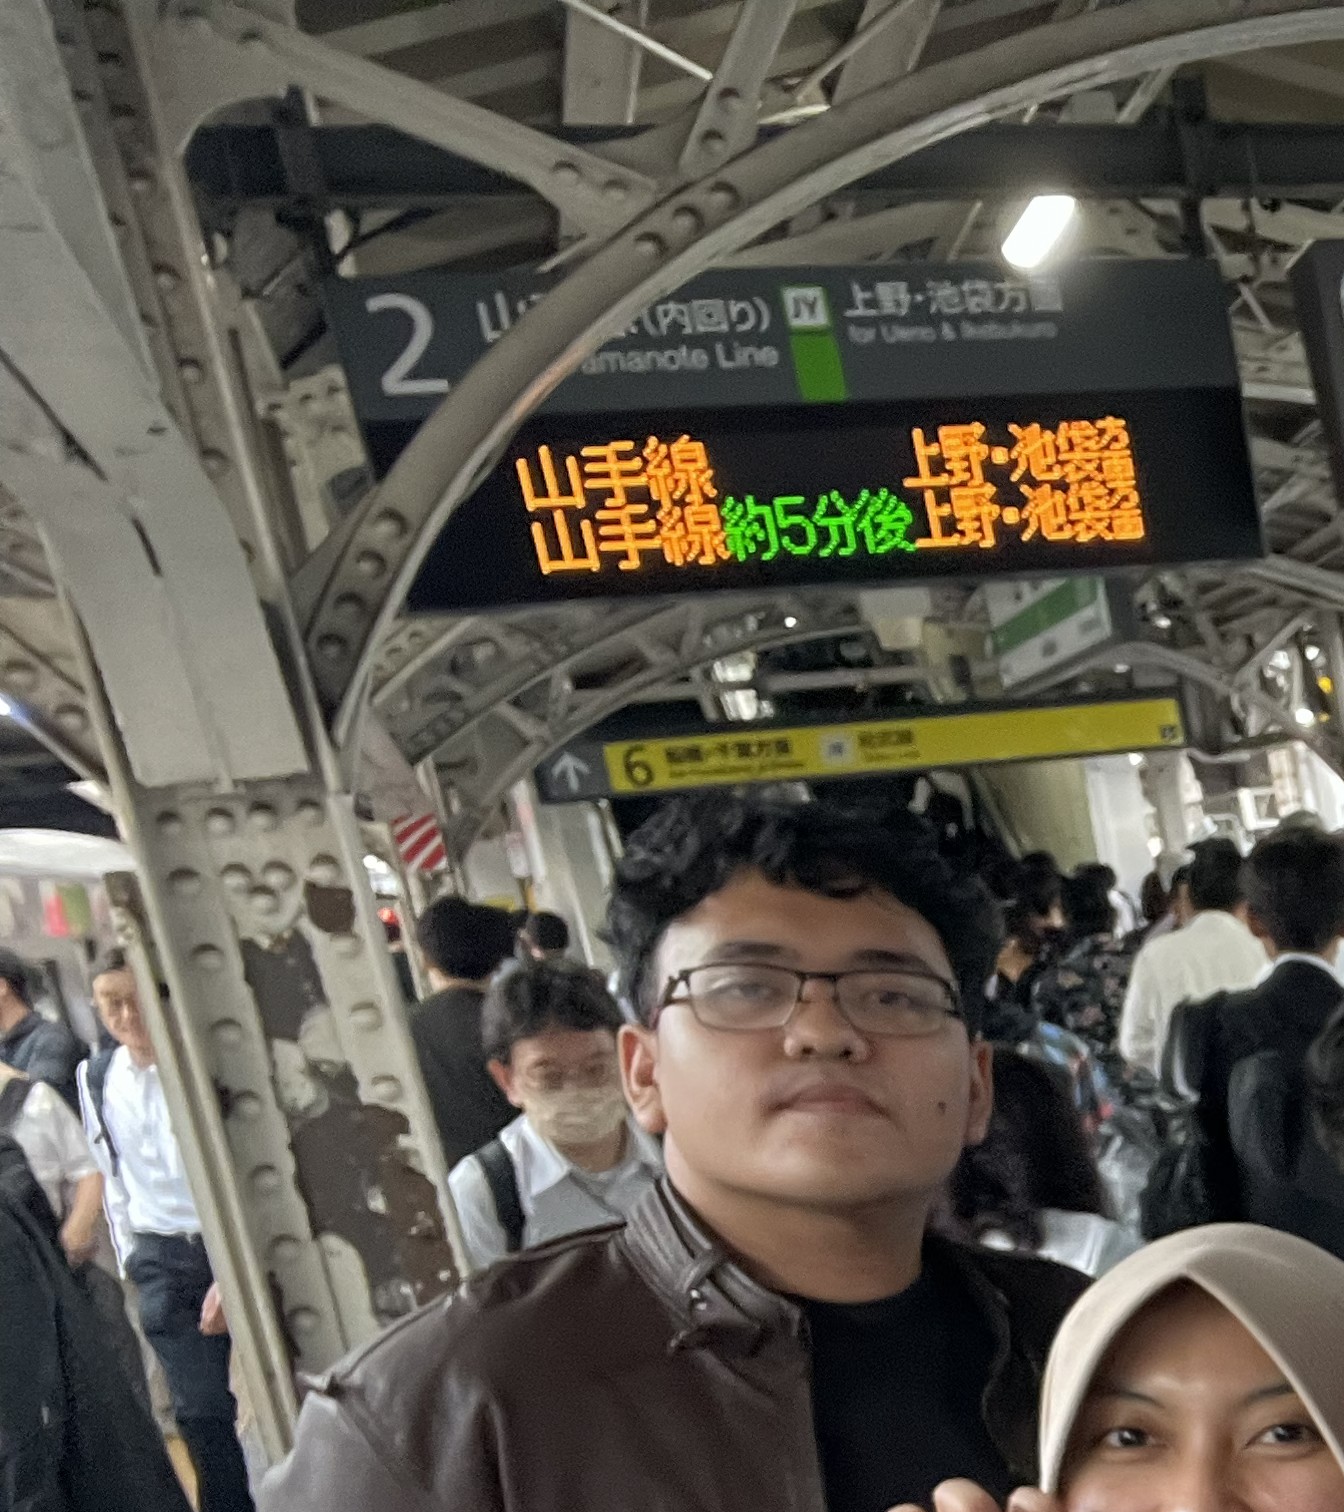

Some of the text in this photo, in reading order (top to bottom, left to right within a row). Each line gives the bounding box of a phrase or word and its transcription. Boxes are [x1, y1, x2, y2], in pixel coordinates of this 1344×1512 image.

[366, 292, 450, 396] 2
[476, 290, 770, 343] 山(内回り)
[582, 339, 780, 375] amanote Line
[515, 435, 718, 512] 山手線
[531, 503, 731, 575] 山手線
[720, 486, 918, 562] 約5分後
[622, 746, 655, 787] 6
